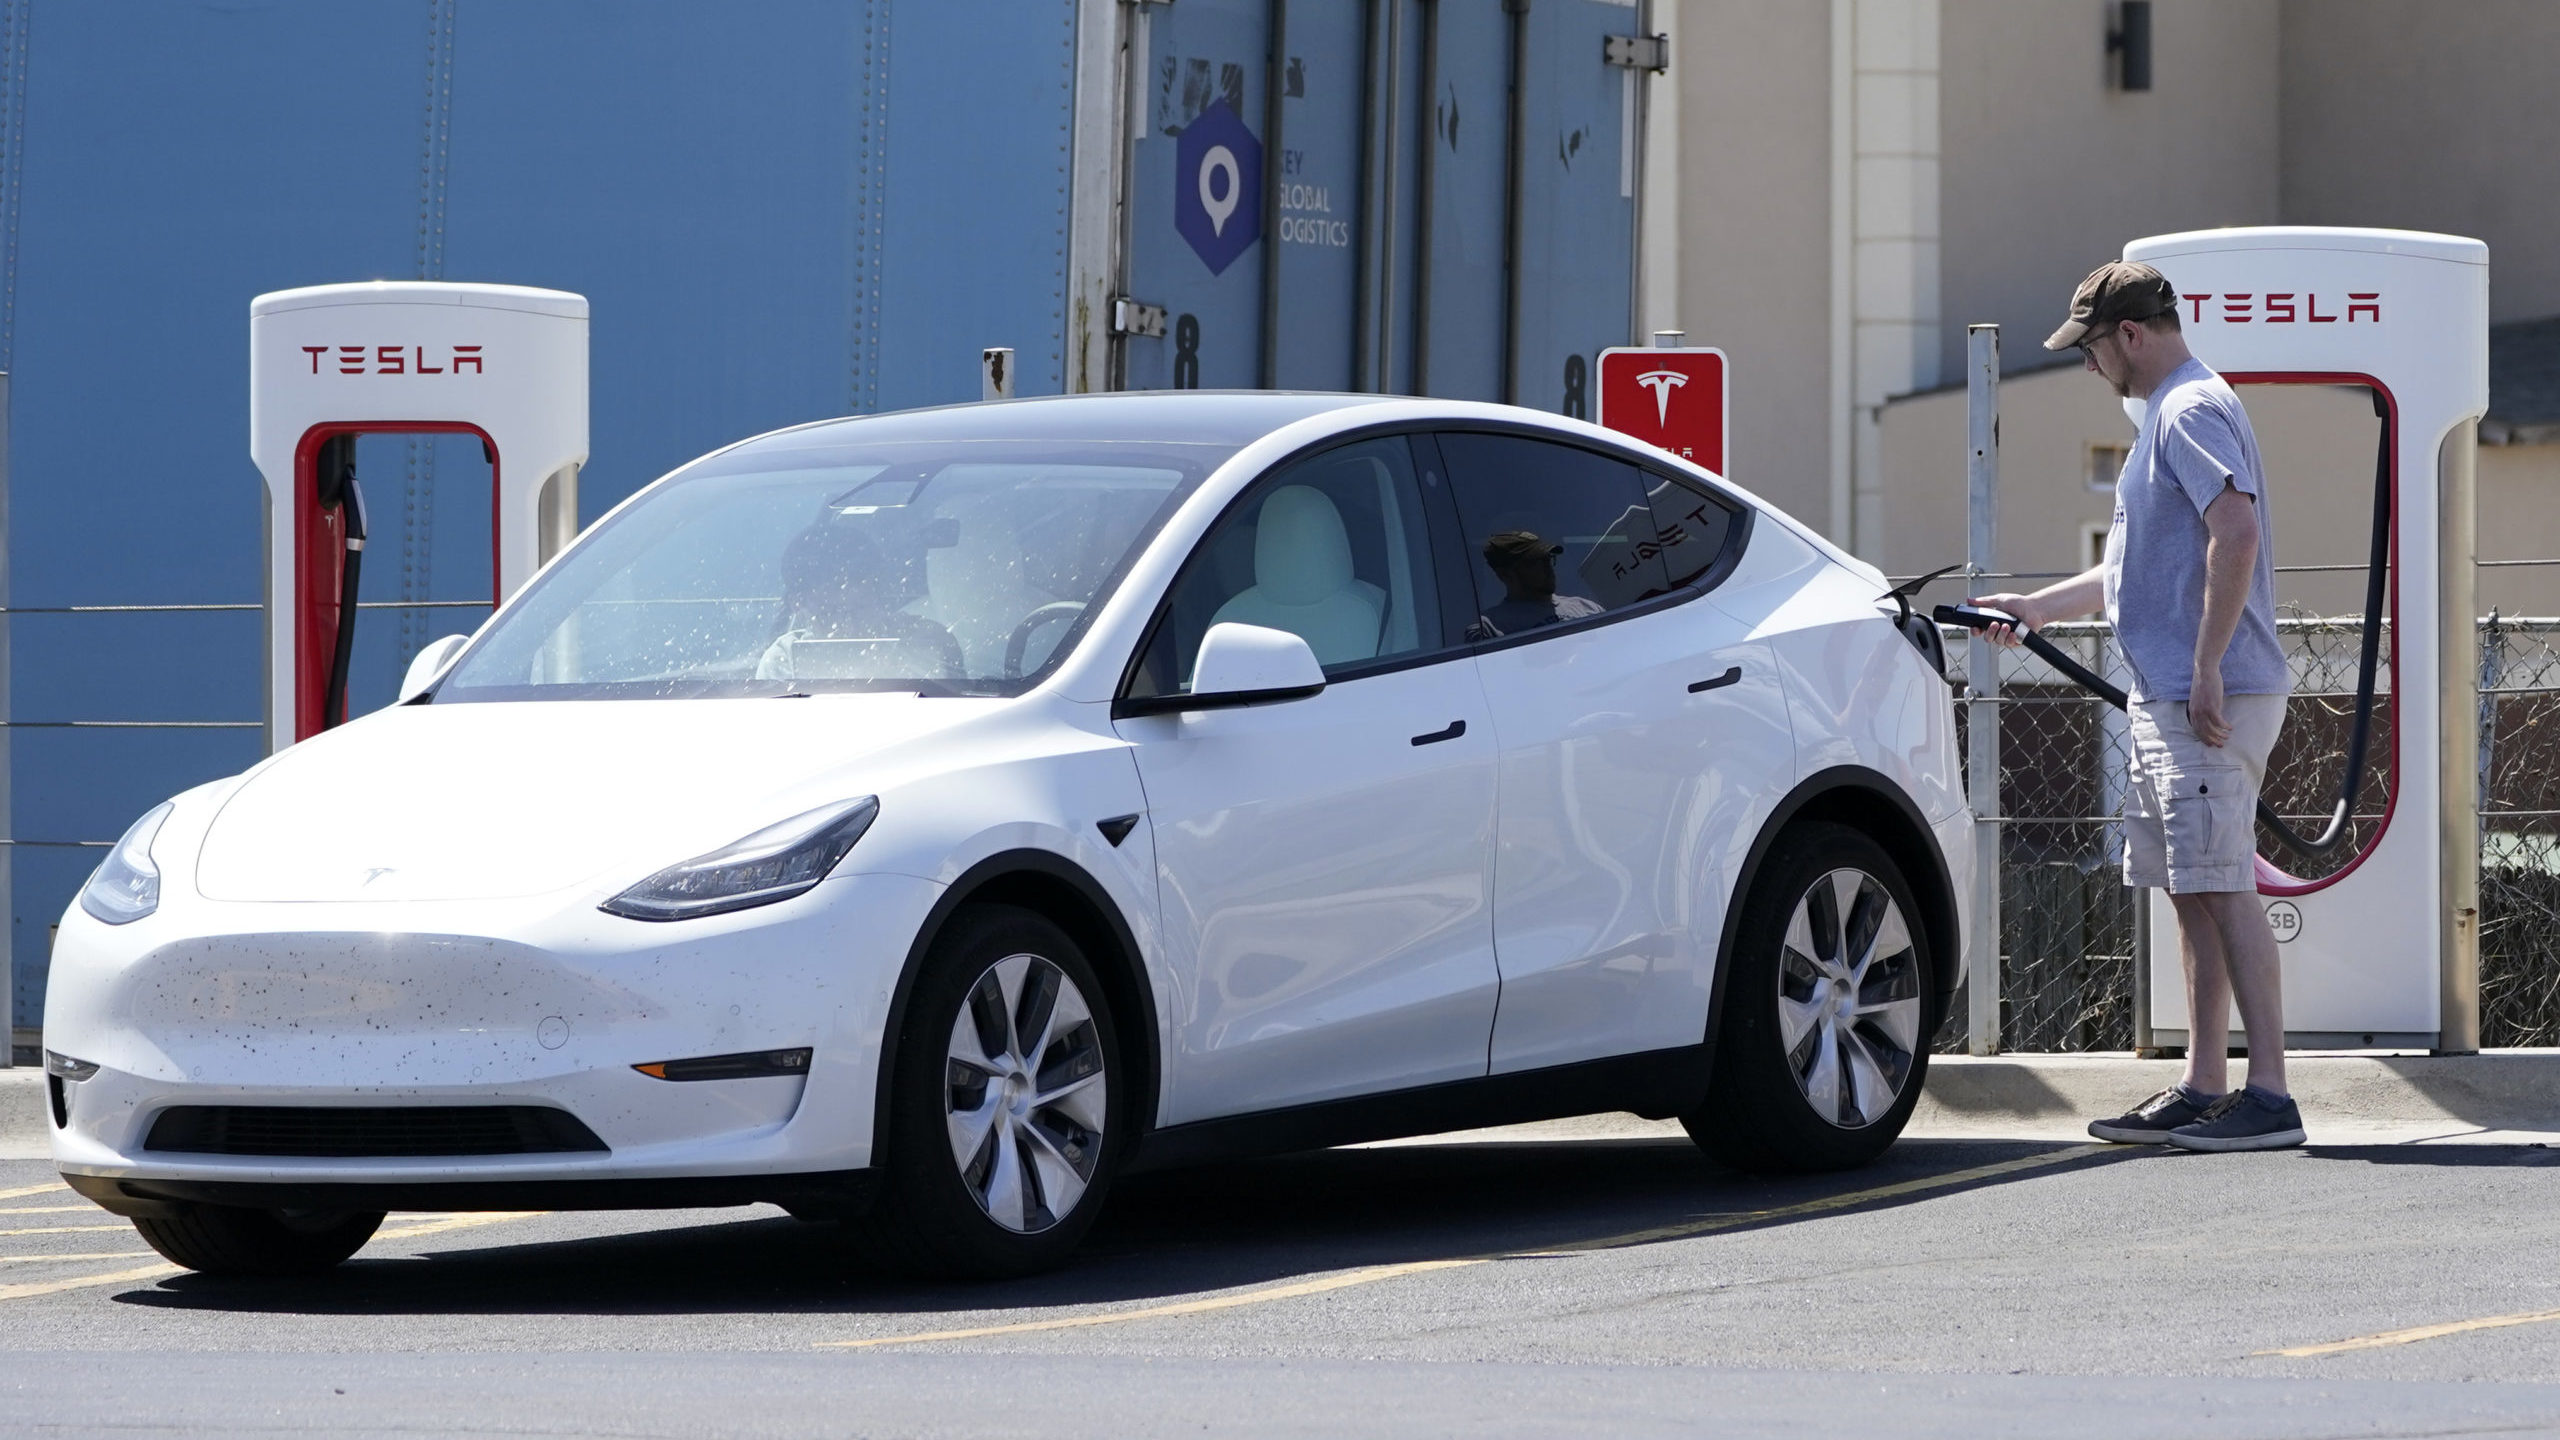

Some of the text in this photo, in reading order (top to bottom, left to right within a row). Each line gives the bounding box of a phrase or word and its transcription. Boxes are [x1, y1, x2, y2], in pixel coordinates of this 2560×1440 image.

[1281, 149, 1303, 175] EY
[1280, 217, 1348, 247] OGISTICS
[2182, 293, 2380, 323] TESLA
[302, 346, 483, 375] TESLA
[2270, 913, 2296, 929] 3B
